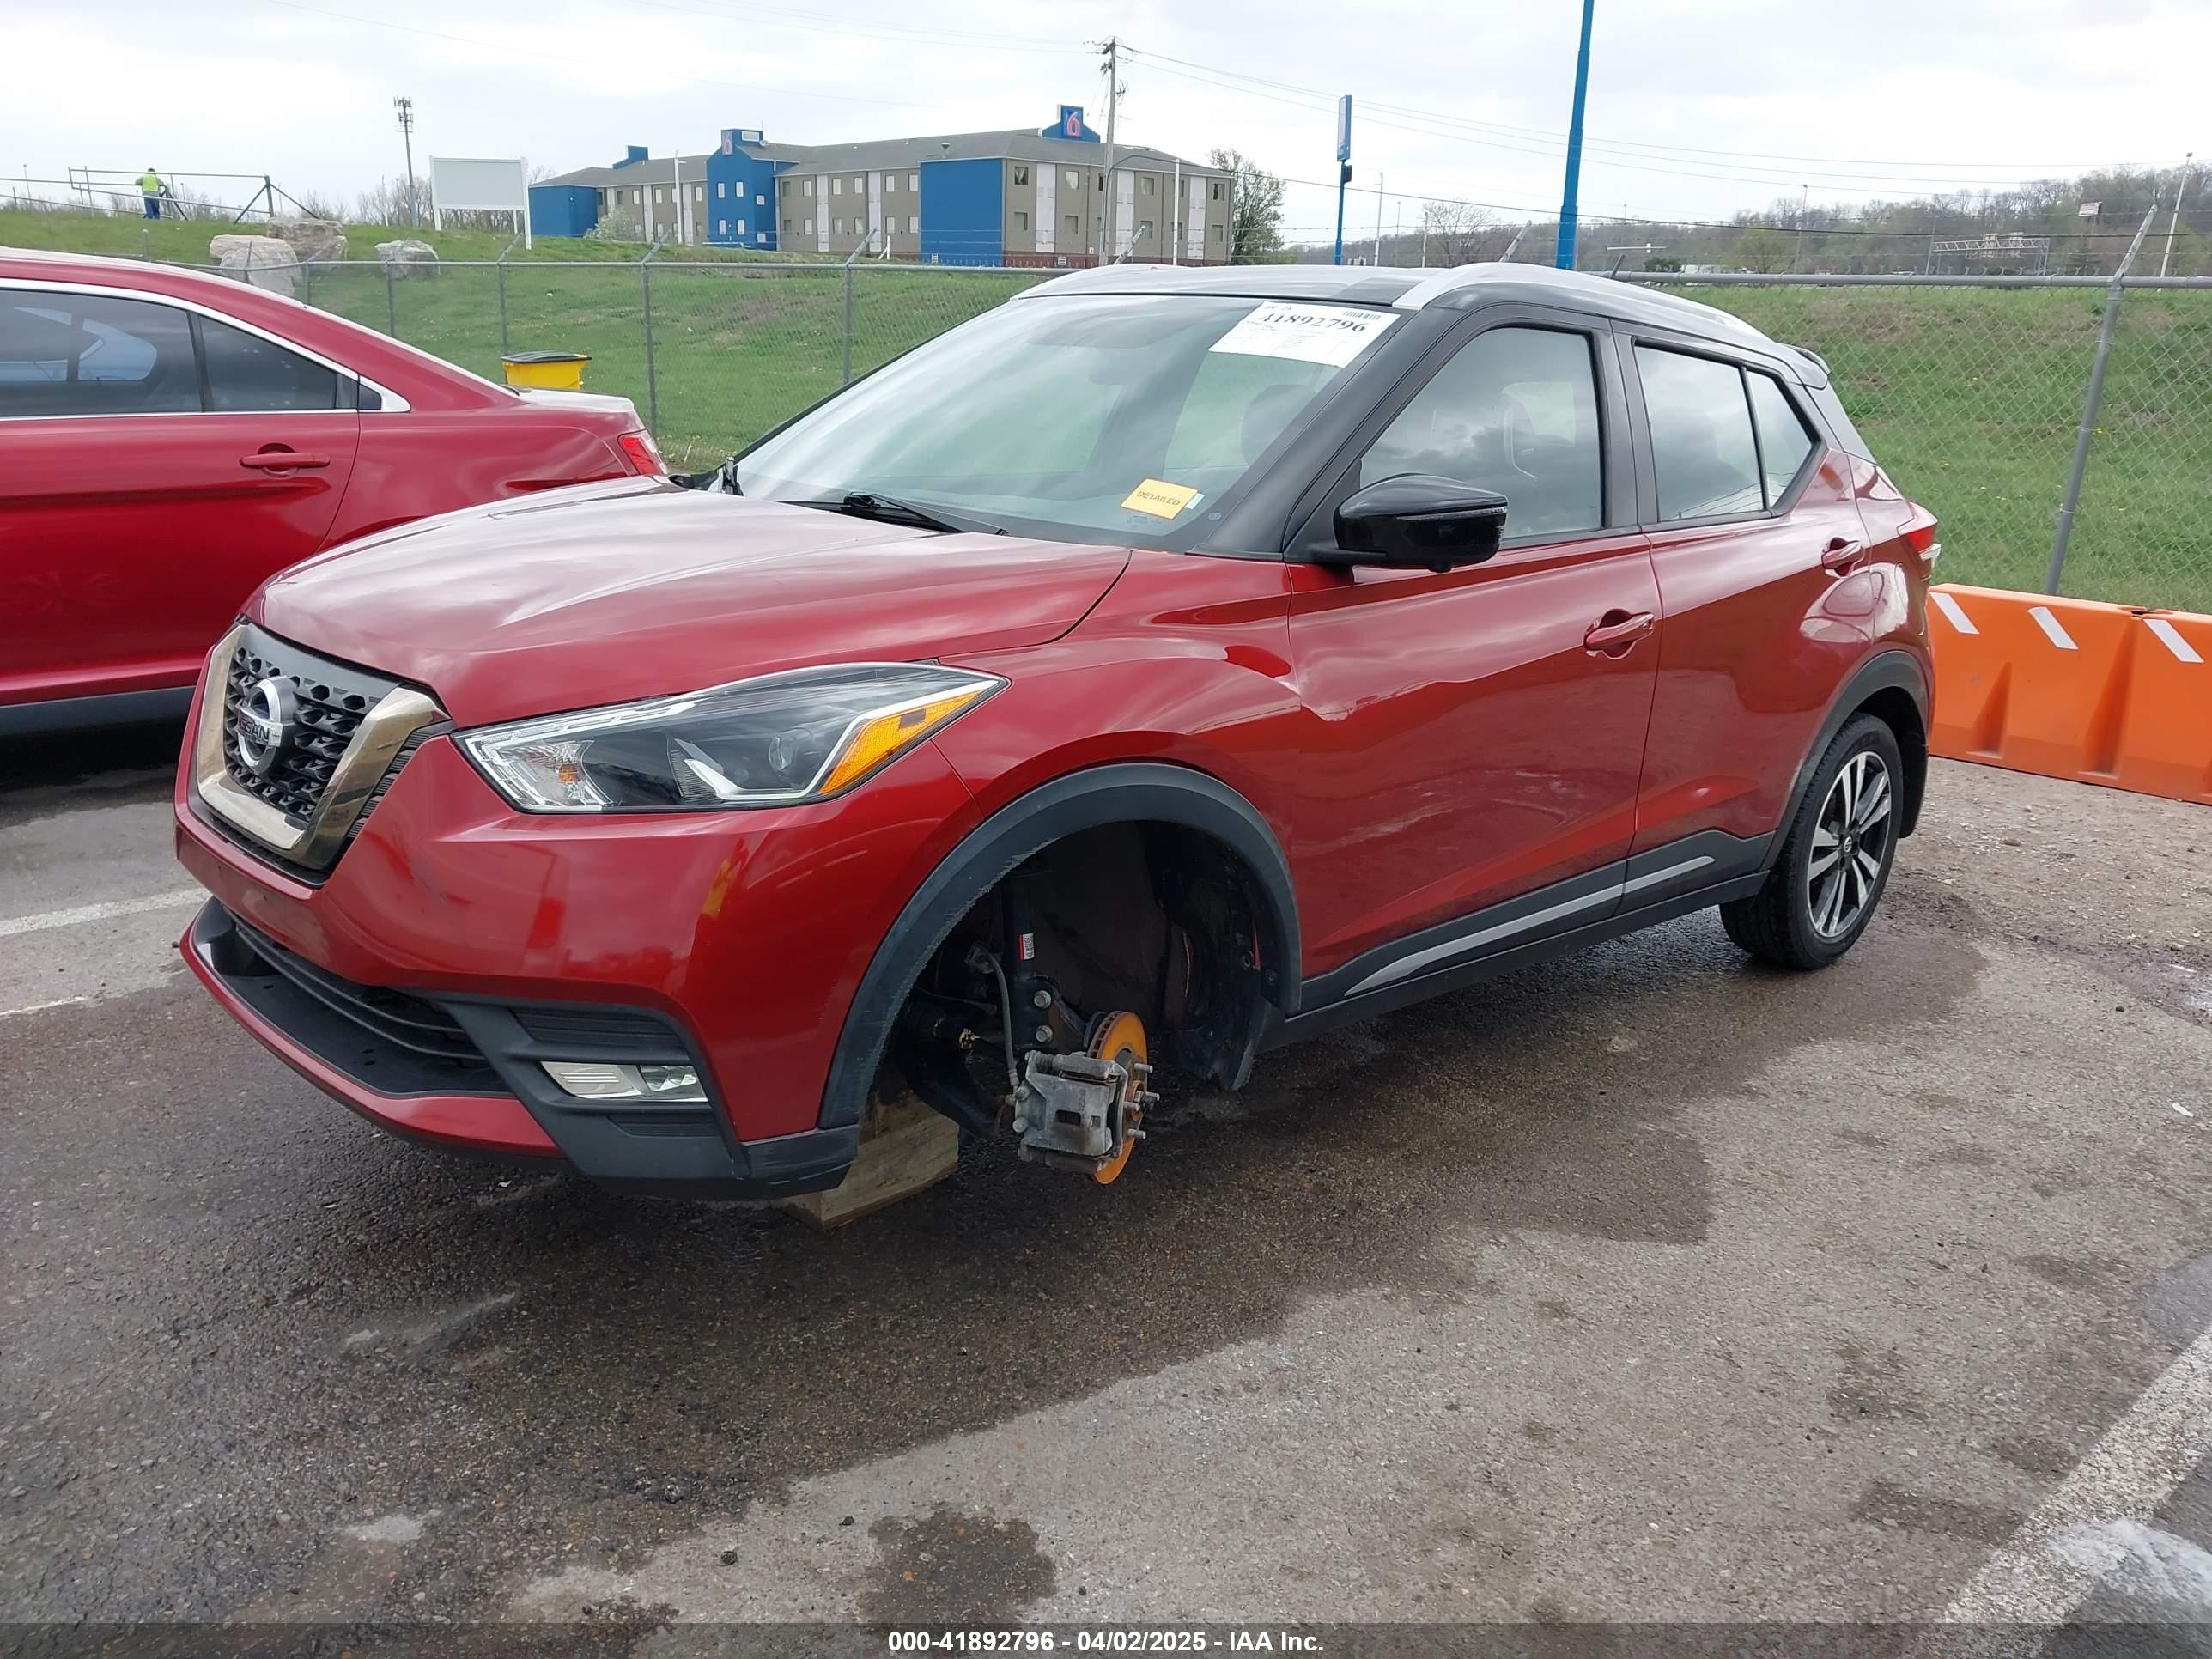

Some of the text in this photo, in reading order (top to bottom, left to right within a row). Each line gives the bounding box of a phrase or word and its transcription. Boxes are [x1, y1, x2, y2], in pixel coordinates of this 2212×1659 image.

[1067, 111, 1080, 137] 6
[1258, 313, 1367, 333] 41892796
[1136, 490, 1181, 507] DETAILED
